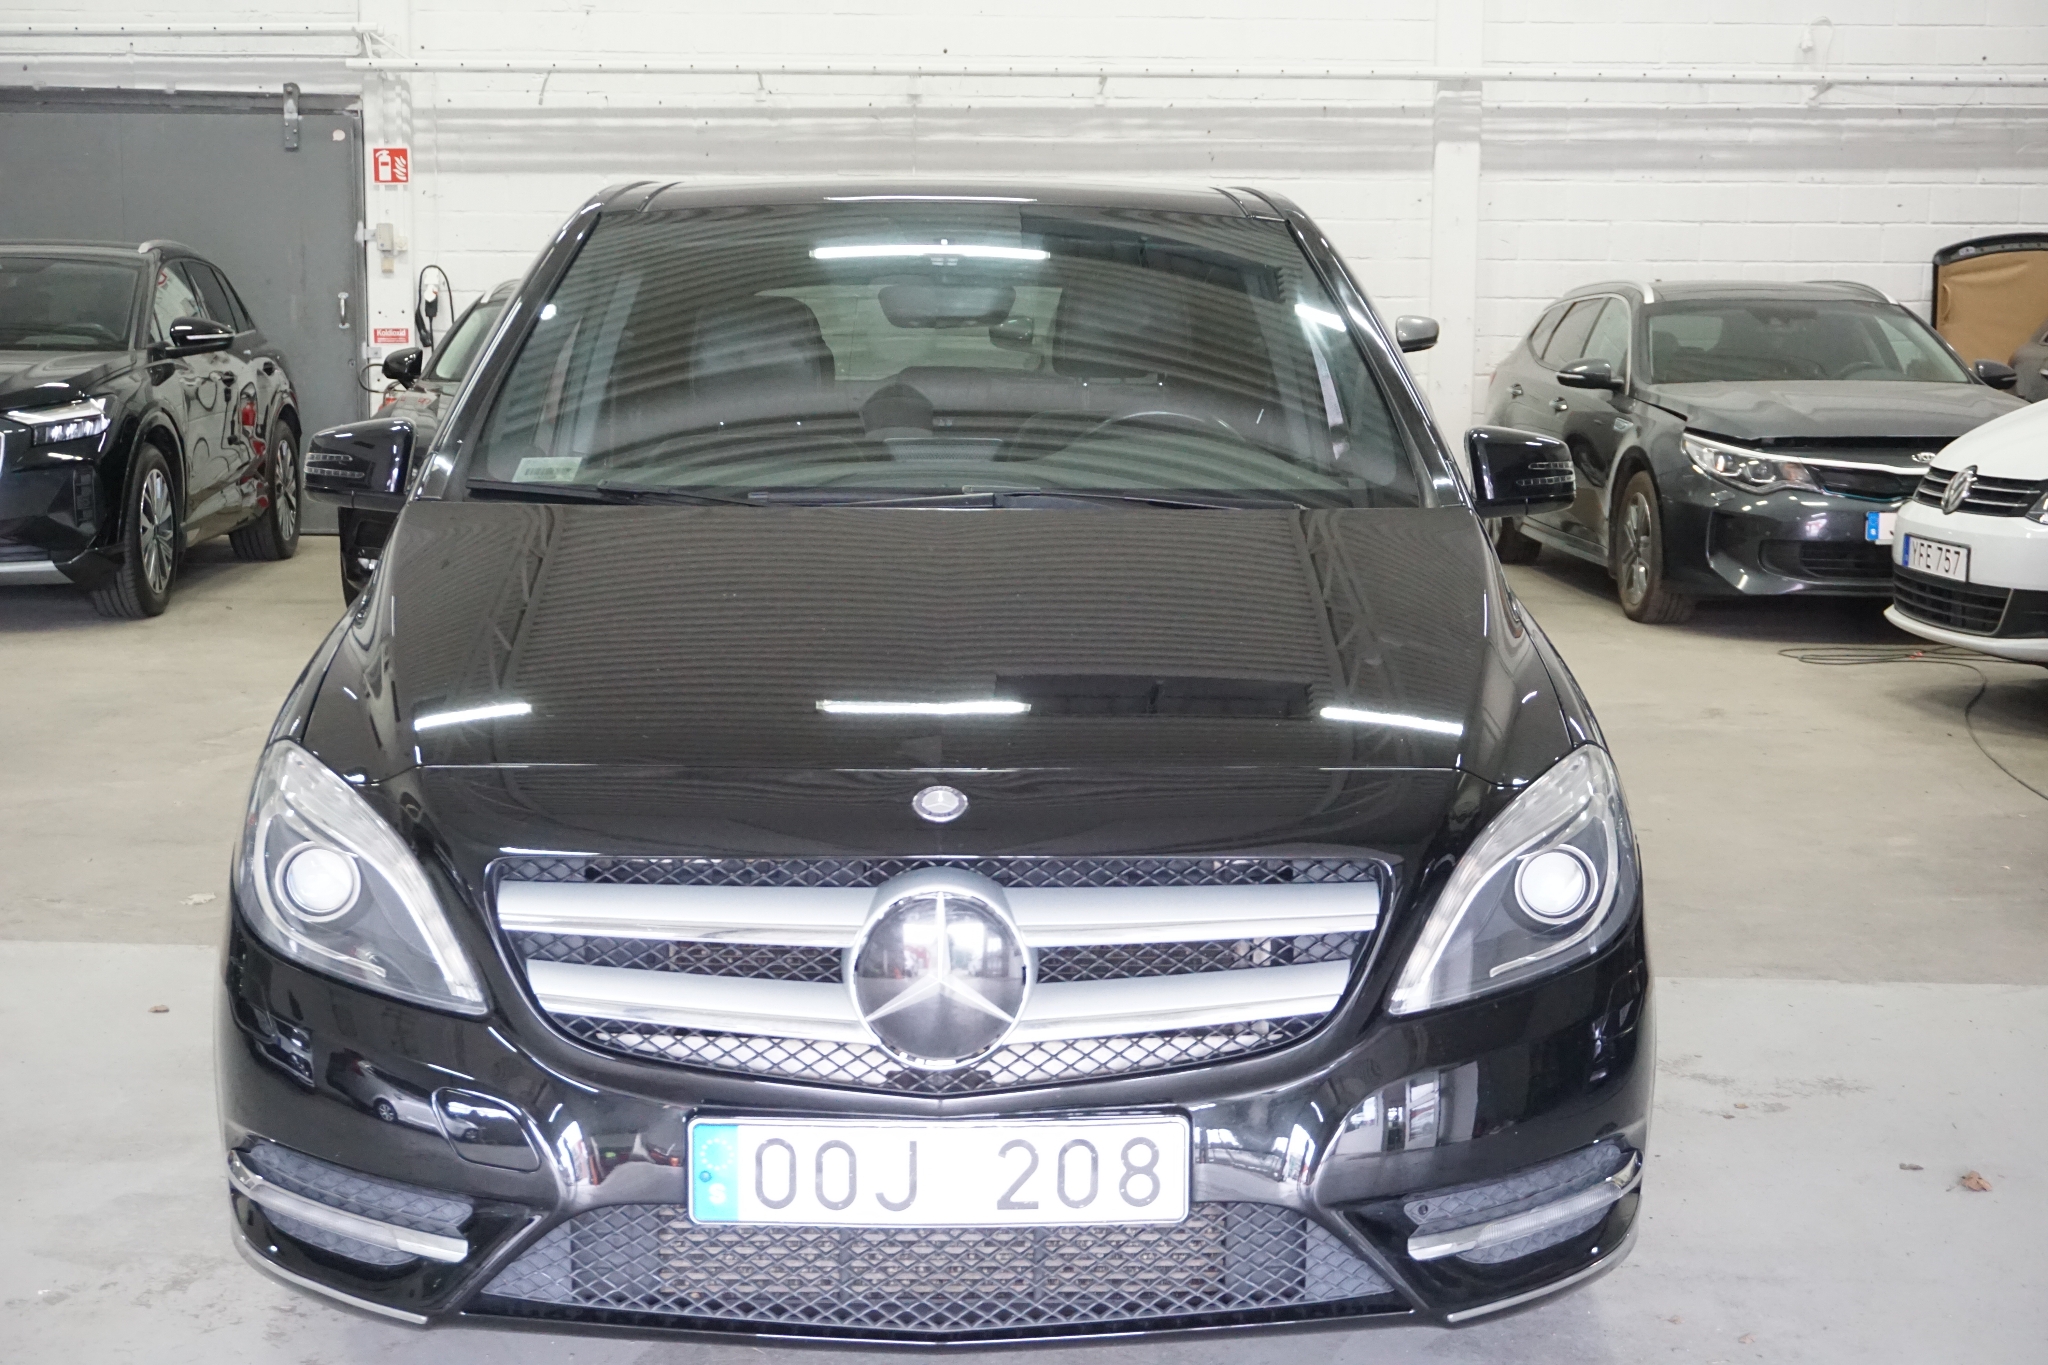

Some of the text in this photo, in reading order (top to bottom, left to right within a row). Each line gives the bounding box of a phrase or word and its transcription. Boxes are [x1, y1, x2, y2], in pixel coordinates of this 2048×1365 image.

[1912, 540, 1961, 575] YFE 757
[708, 1136, 1161, 1211] S OOJ 208
